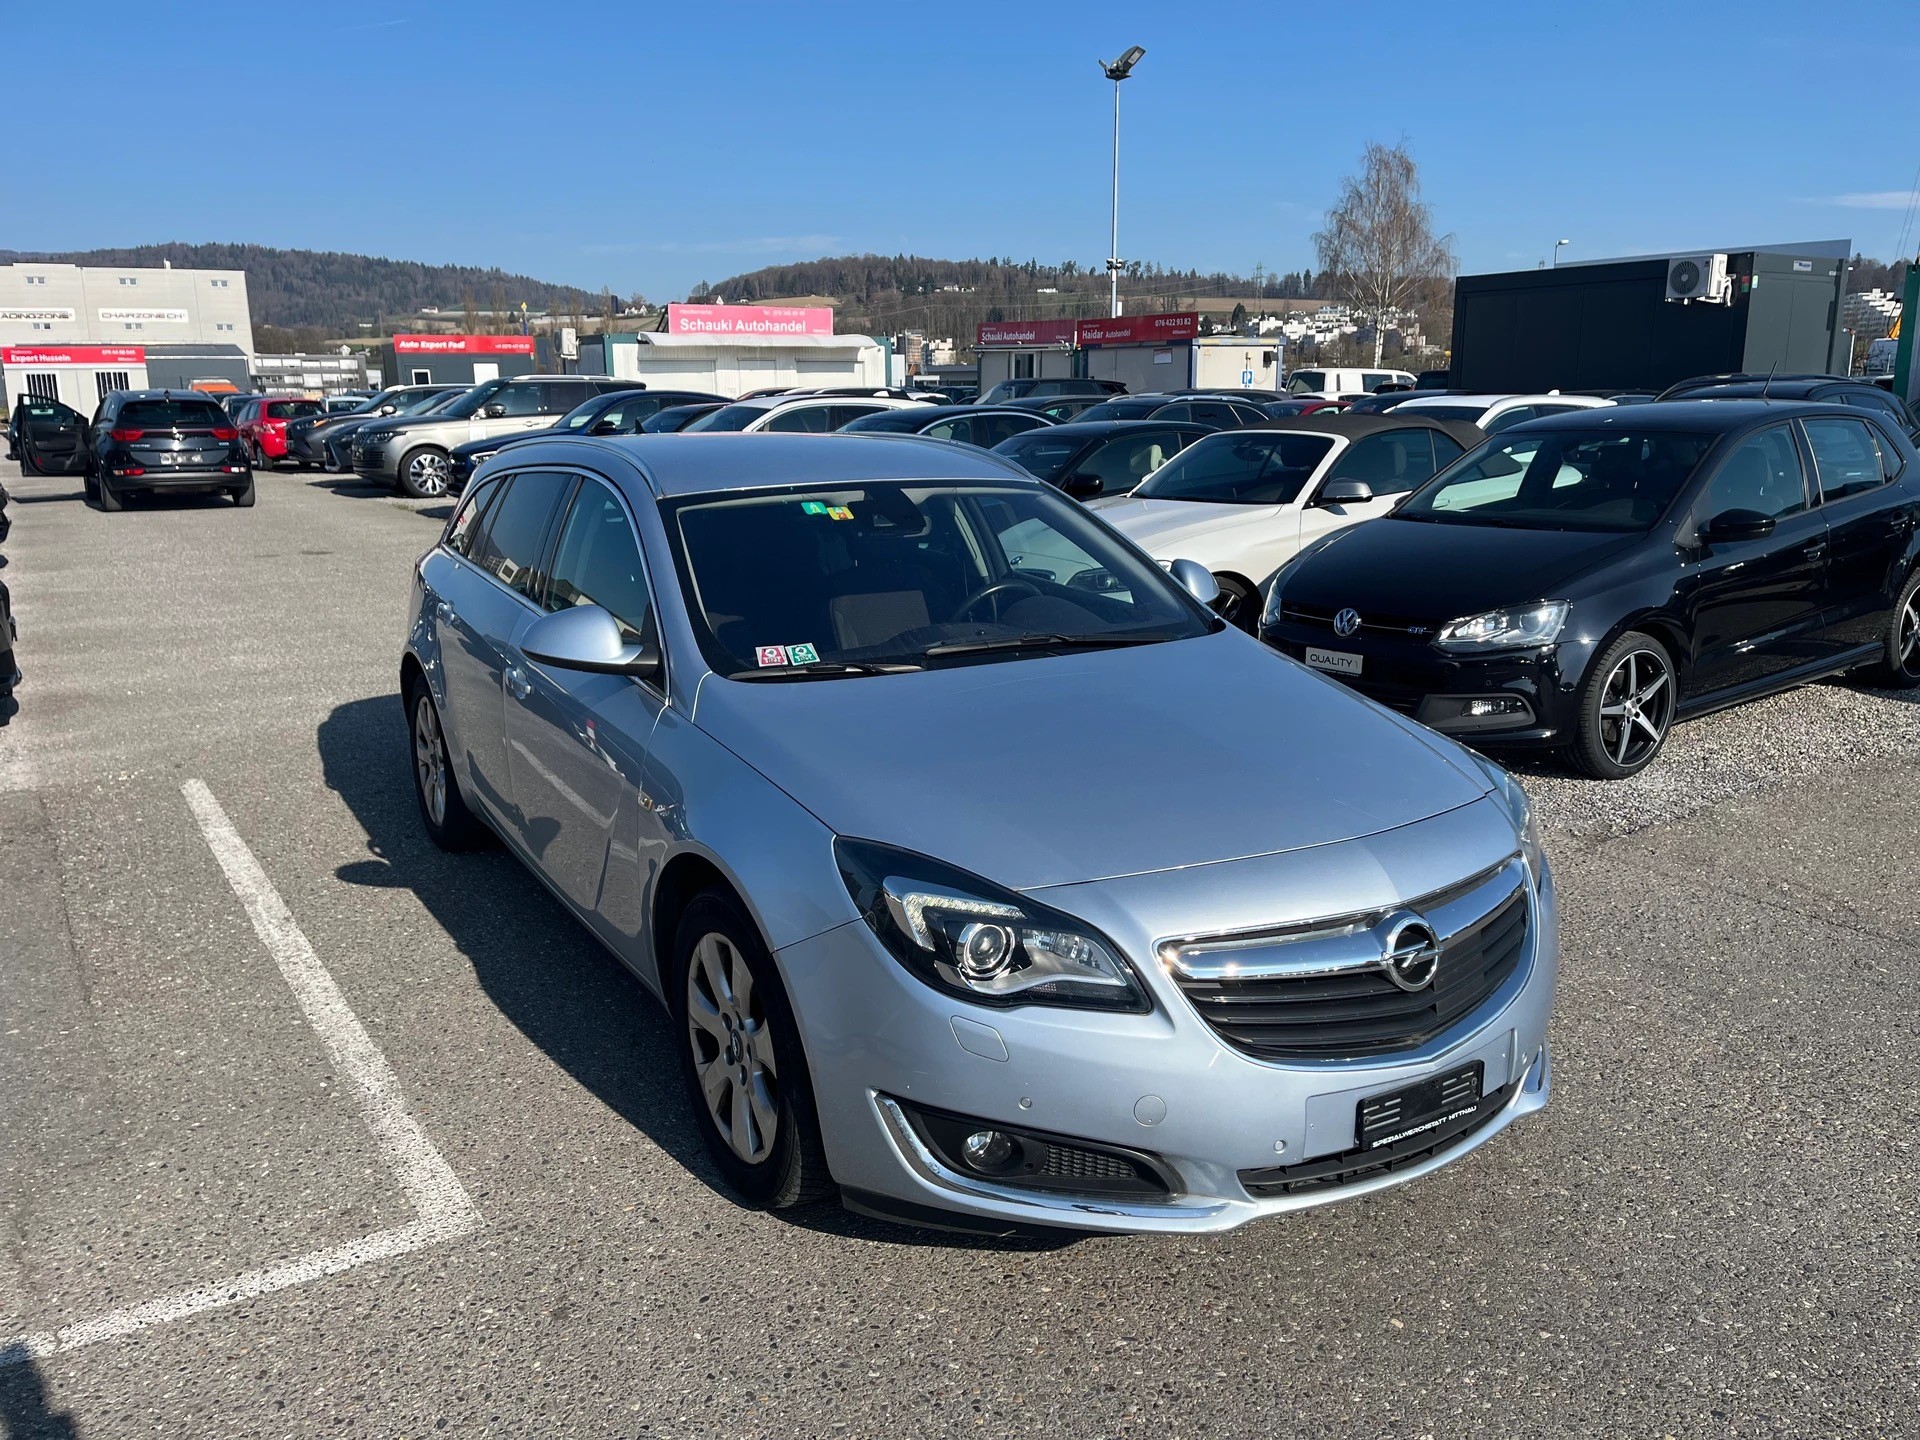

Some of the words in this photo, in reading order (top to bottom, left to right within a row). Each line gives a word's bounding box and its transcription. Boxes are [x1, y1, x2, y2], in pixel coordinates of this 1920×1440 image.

[680, 318, 732, 331] Schauki
[735, 319, 806, 332] Autohandel
[1155, 319, 1165, 327] 076
[1165, 318, 1176, 326] 422
[1176, 318, 1184, 326] 93
[1184, 317, 1191, 325] 82
[981, 332, 1002, 341] Schauki
[1003, 331, 1036, 340] Autohandel
[1082, 329, 1104, 339] Haidar
[1105, 329, 1131, 338] Autohandel
[399, 340, 419, 349] Auto
[39, 354, 71, 363] Hussein
[1448, 1105, 1477, 1121] HITTNAU
